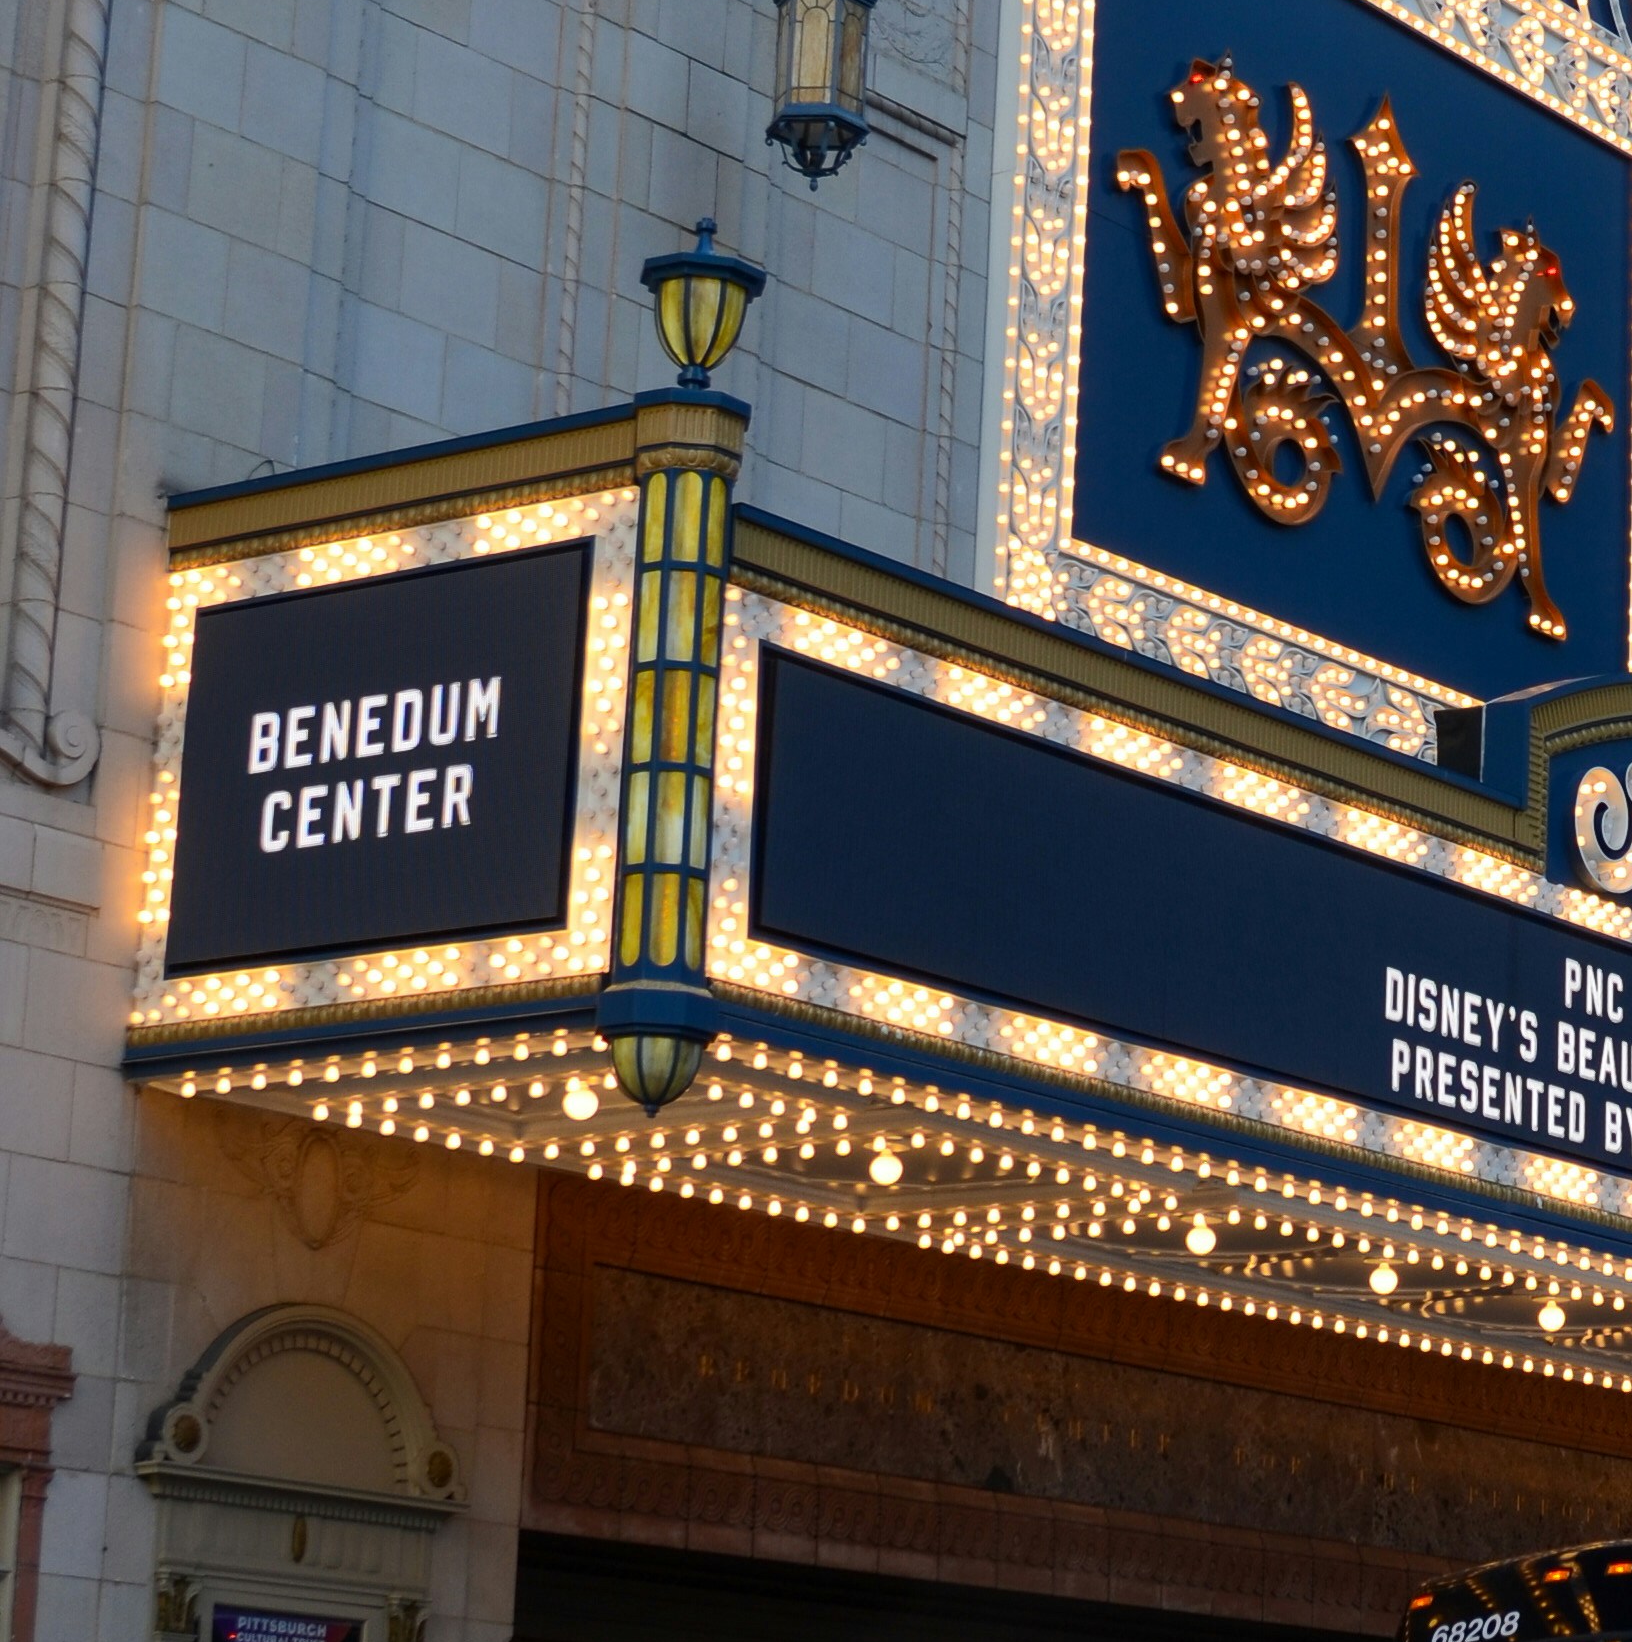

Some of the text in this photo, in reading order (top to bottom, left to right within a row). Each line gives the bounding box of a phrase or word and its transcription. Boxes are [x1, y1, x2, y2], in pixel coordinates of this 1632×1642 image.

[248, 676, 502, 775] BENEDUM
[260, 763, 474, 853] CENTER
[1385, 966, 1538, 1063] DISNEY'S
[1564, 957, 1624, 1024] PNC
[1391, 1038, 1586, 1143] PRESENTED
[237, 1616, 327, 1639] PITTSBURGH
